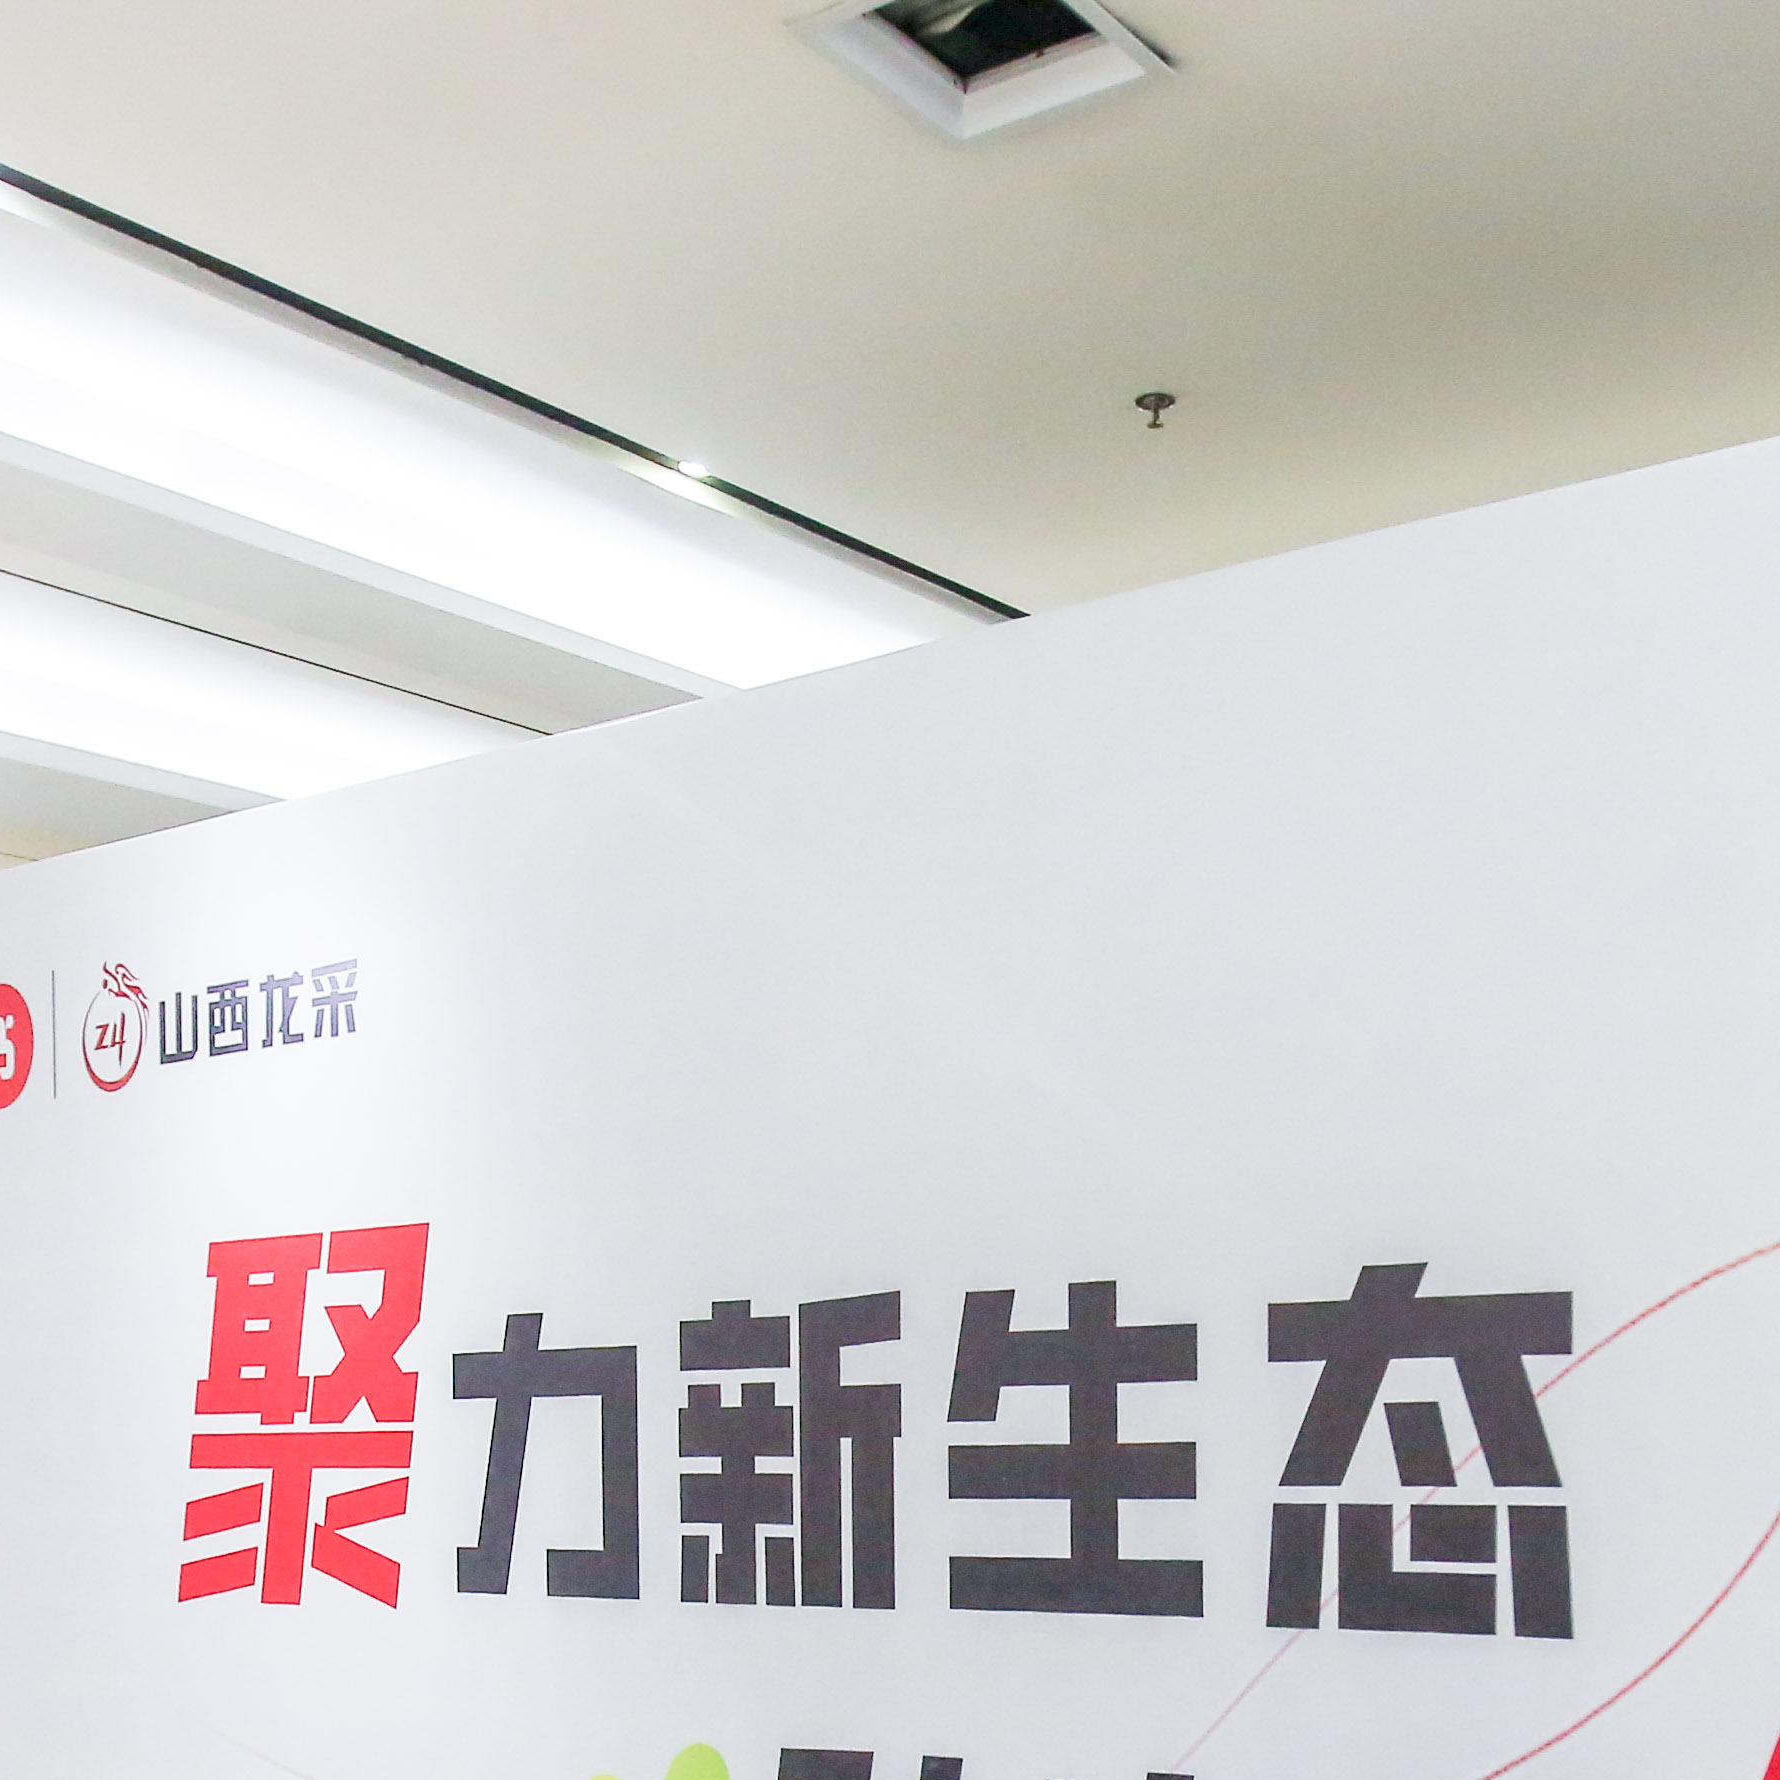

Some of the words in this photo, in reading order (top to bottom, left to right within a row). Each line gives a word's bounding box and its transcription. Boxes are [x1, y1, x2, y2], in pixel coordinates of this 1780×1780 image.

[158, 957, 358, 1064] 山西龙采
[178, 1222, 1574, 1640] 聚力新生态
